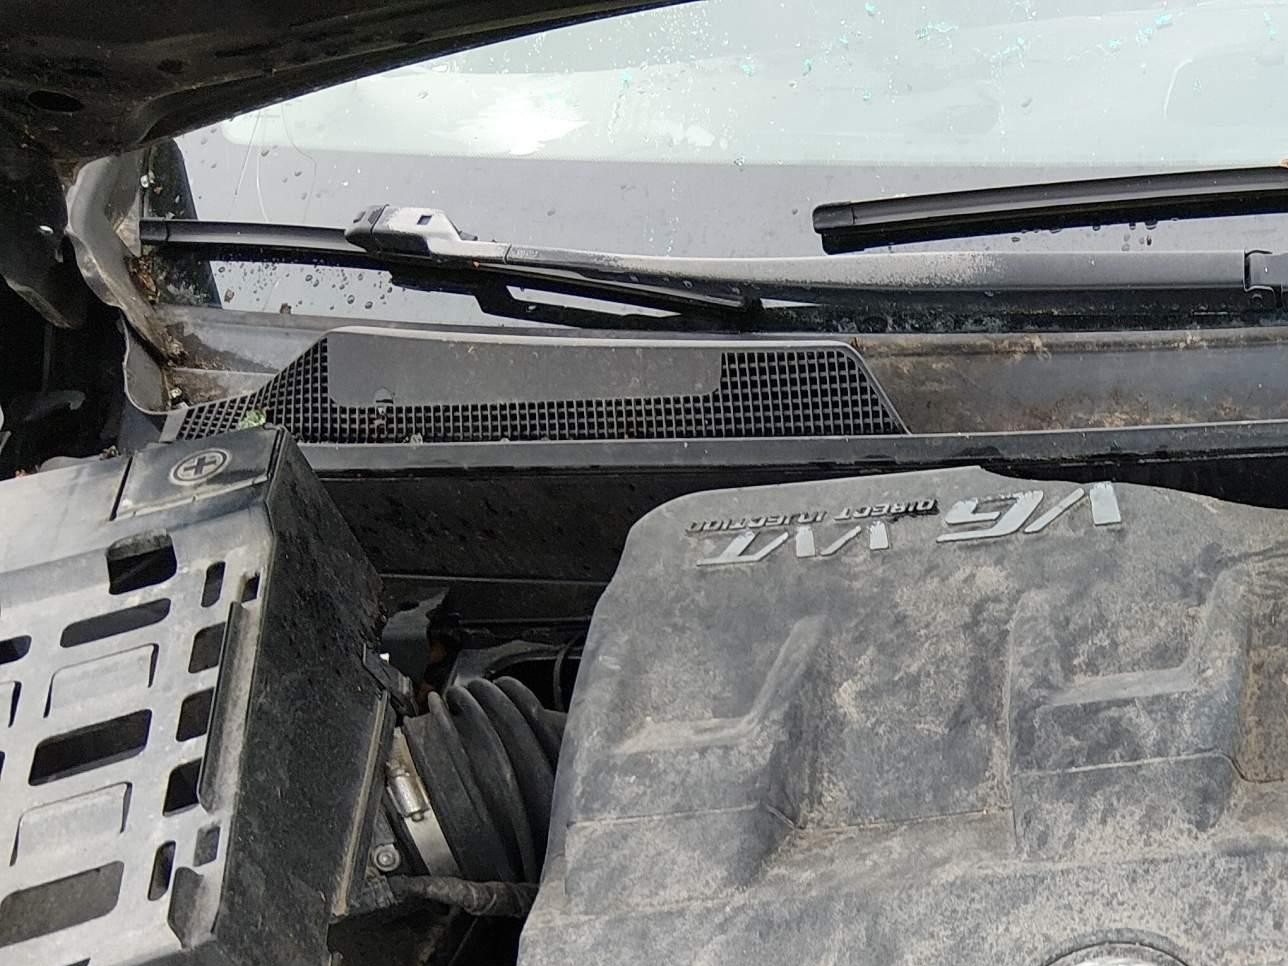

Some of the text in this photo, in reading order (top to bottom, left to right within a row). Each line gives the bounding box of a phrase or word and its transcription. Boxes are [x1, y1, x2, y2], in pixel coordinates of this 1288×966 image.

[684, 498, 938, 533] DIRECT INJECTION
[696, 480, 1121, 566] V6 VVT
